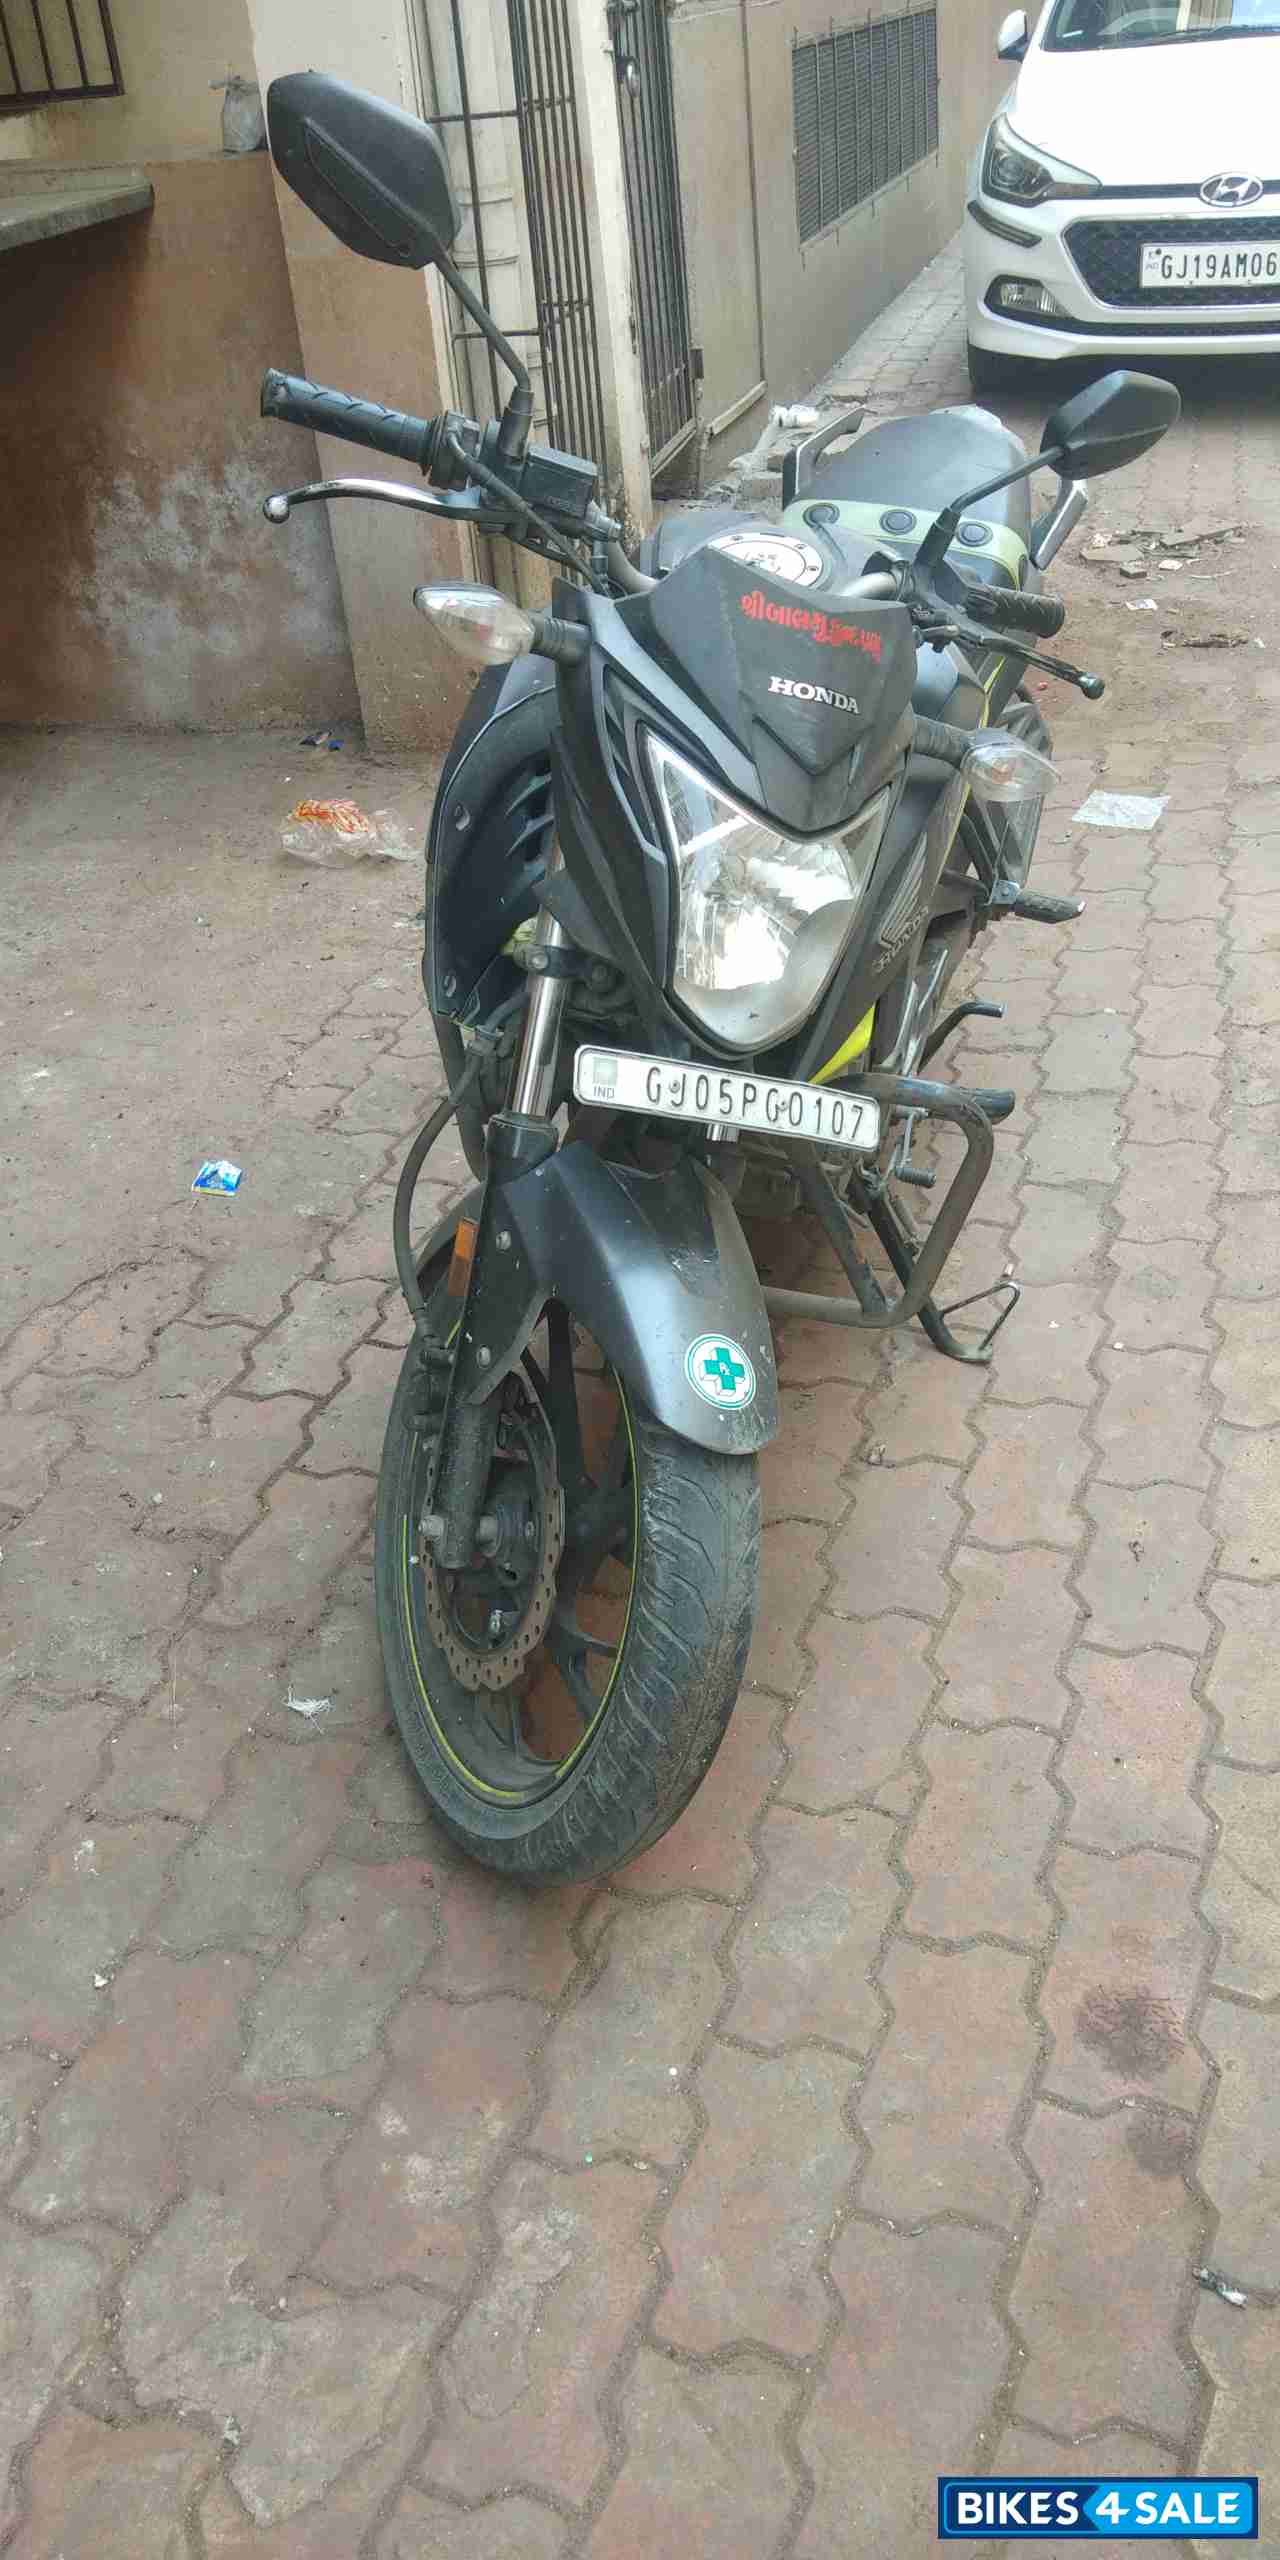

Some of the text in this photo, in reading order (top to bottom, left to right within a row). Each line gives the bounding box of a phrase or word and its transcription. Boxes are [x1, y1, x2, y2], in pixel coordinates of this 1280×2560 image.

[768, 676, 860, 715] HONDA
[593, 1086, 615, 1100] IND
[645, 1067, 865, 1140] GJ05PG0107
